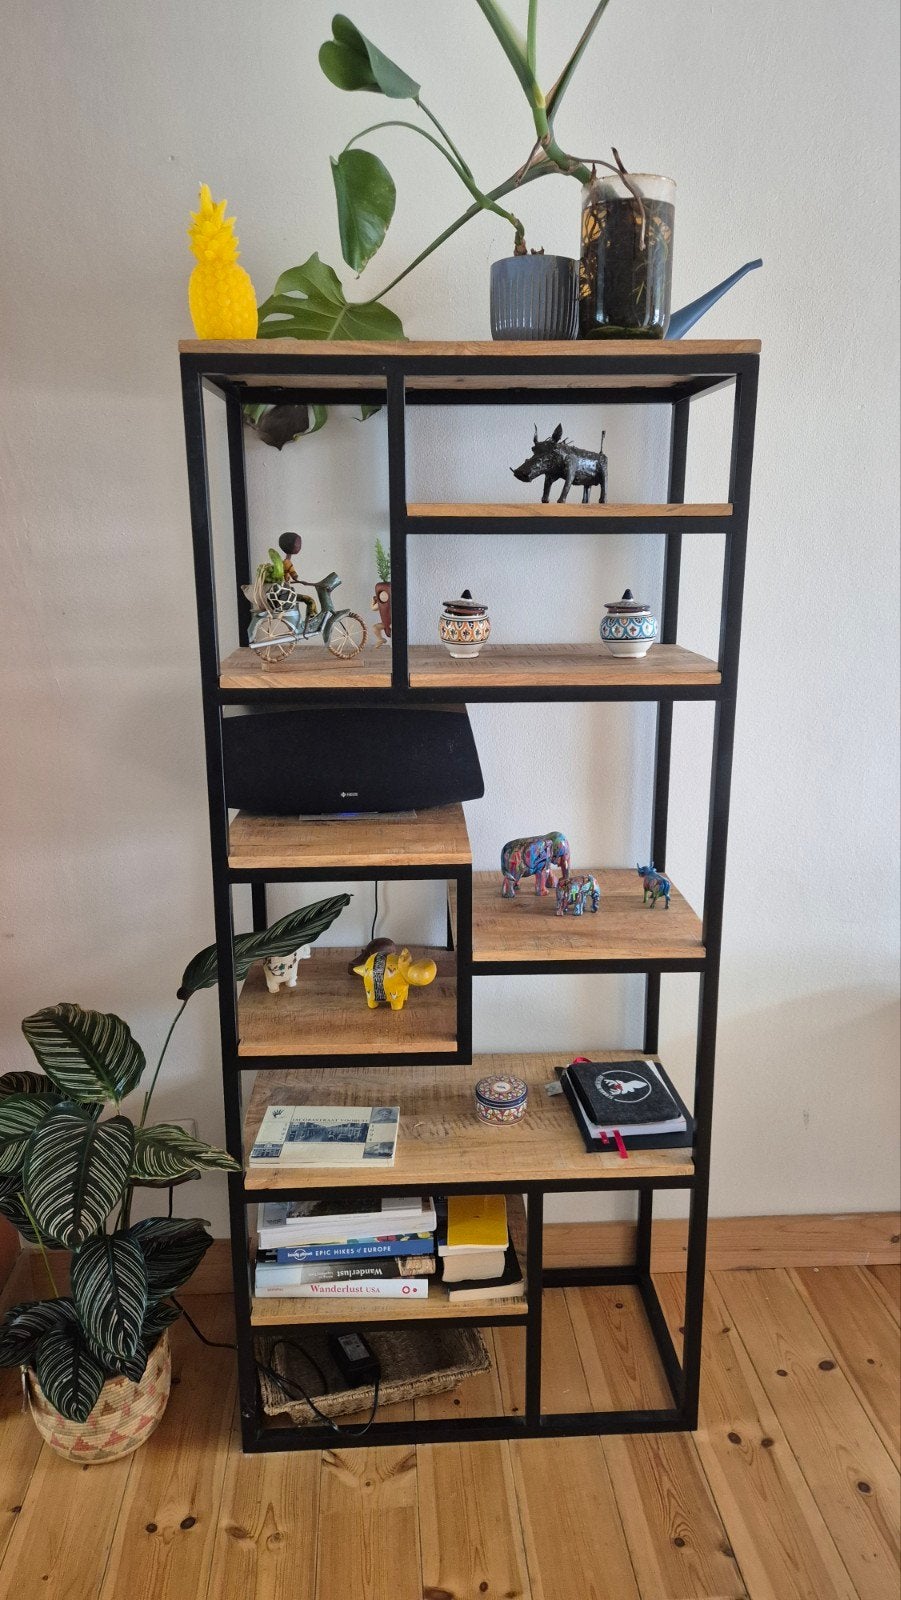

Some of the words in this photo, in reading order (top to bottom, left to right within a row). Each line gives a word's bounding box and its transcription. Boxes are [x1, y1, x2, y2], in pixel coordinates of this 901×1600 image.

[315, 1249, 331, 1257] EPIC
[363, 1245, 392, 1253] EUROPE
[336, 1268, 383, 1277] Wanderlust
[310, 1284, 363, 1293] Wanderlust
